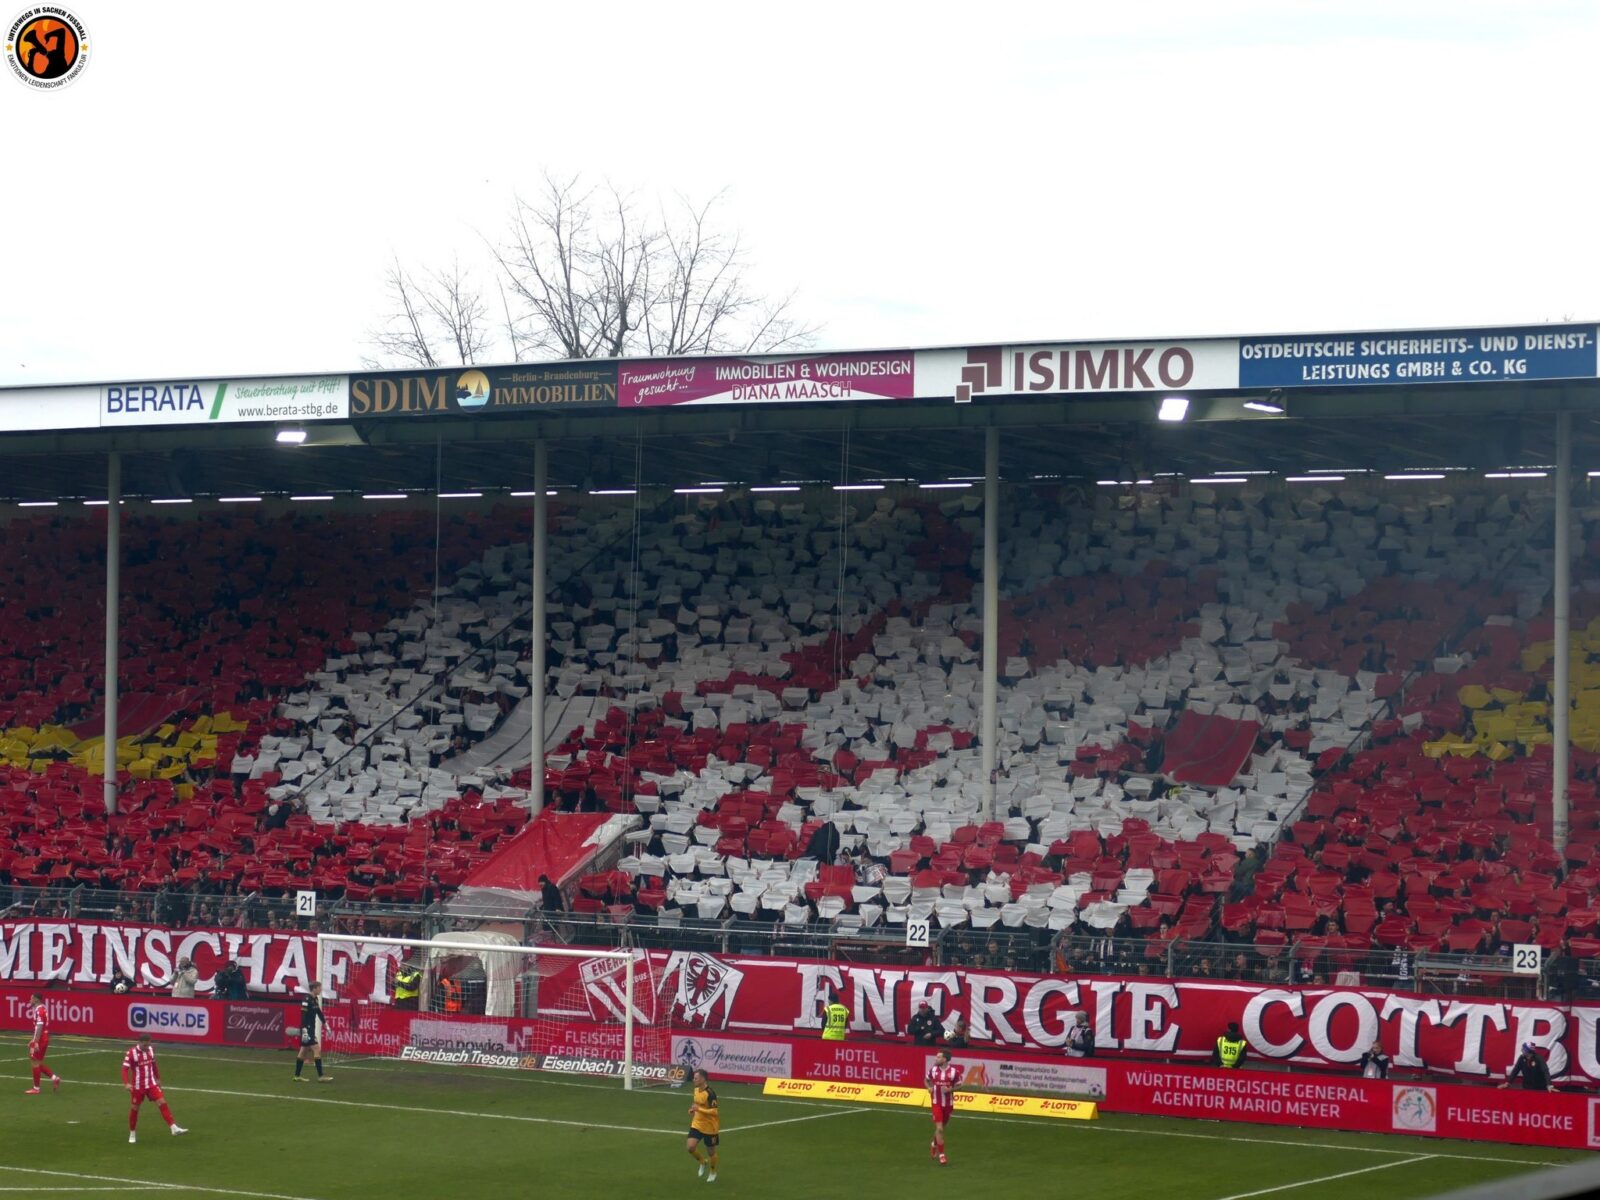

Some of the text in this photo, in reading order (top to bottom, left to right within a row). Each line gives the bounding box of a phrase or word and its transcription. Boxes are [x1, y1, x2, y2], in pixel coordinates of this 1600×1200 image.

[1242, 332, 1593, 360] OSTDEUTSCHE SICHERHEITS- UND DIENST-
[512, 372, 537, 382] Berlin
[544, 370, 599, 381] Brandenburg
[621, 365, 696, 386] Traumwohnung
[716, 360, 911, 380] IMMOBILIEN & WOHNDESIGN
[1014, 347, 1194, 392] ISIMKO
[1302, 358, 1527, 380] LEISTUNGS GMBH & CO. KG
[107, 384, 204, 413] BERATA
[235, 384, 298, 400] Steuerberatung
[351, 376, 449, 414] SDIM
[495, 383, 616, 406] IMMOBILIEN
[732, 381, 852, 401] DIANA MAASCH
[238, 402, 338, 417] www.berata-stbg.de
[301, 896, 312, 911] 21
[910, 925, 926, 941] 22
[1517, 950, 1537, 968] 23
[794, 963, 1179, 1053] ENERGIE
[833, 1014, 844, 1022] 316
[365, 1033, 400, 1046] GMBH
[565, 1031, 645, 1048] FLEISCHEEI
[401, 1046, 469, 1064] Eisenbach
[705, 1043, 786, 1066] Spreewaldeck
[835, 1048, 879, 1064] HOTEL
[1224, 1046, 1236, 1055] 315
[542, 1055, 613, 1074] Eisenbach
[837, 1086, 861, 1095] LOTTO
[886, 1090, 910, 1098] LOTTO
[1127, 1070, 1368, 1102] WÜRTTEMBERGISCHE GENERAL
[953, 1094, 974, 1103] OTTO
[999, 1098, 1024, 1107] LOTTO
[1051, 1102, 1077, 1111] LOTTO
[1152, 1091, 1340, 1118] AGENTUR MARIO MEYER
[1447, 1107, 1573, 1130] FLIESEN HOCKE
